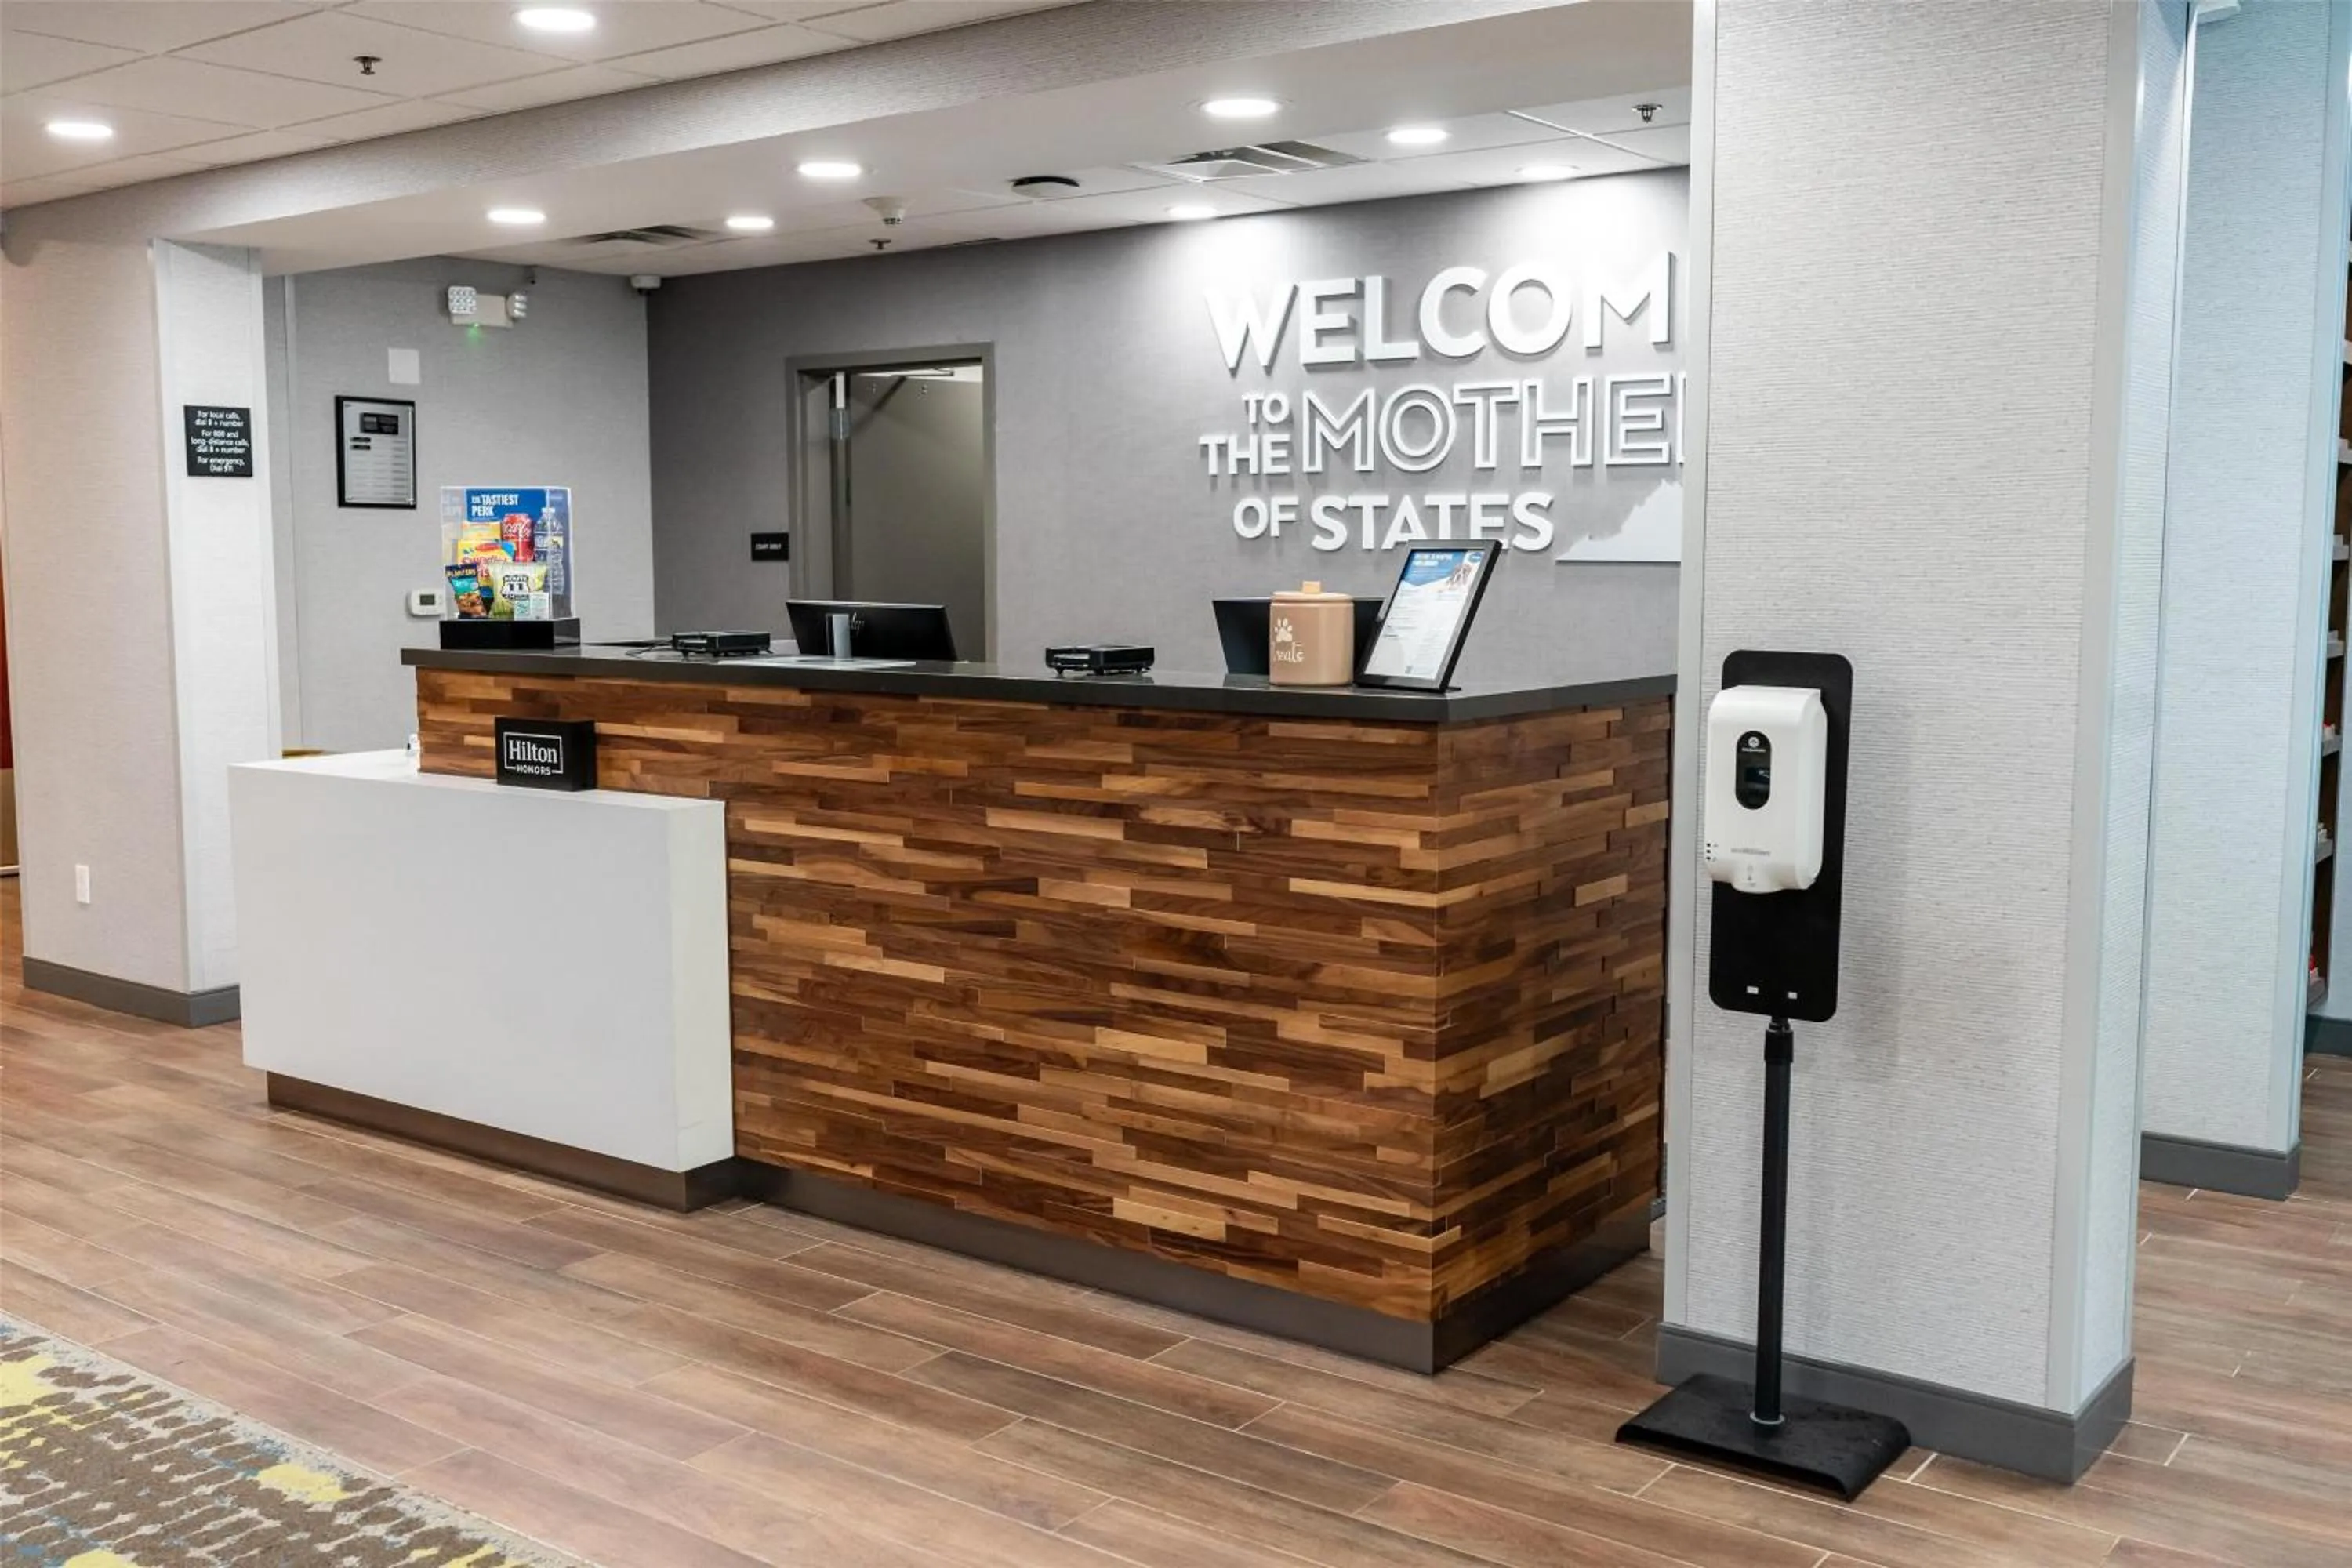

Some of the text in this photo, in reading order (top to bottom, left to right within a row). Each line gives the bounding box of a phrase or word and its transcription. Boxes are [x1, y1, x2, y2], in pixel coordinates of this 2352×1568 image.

[1204, 251, 1675, 368] WELCOM
[1242, 391, 1290, 424] TO
[1199, 371, 1686, 475] THE MOTHE
[471, 506, 494, 517] PERK
[481, 494, 520, 506] TASTIEST
[1232, 492, 1555, 552] OF STATES
[509, 739, 558, 764] Hilton
[517, 764, 551, 775] HONORS
